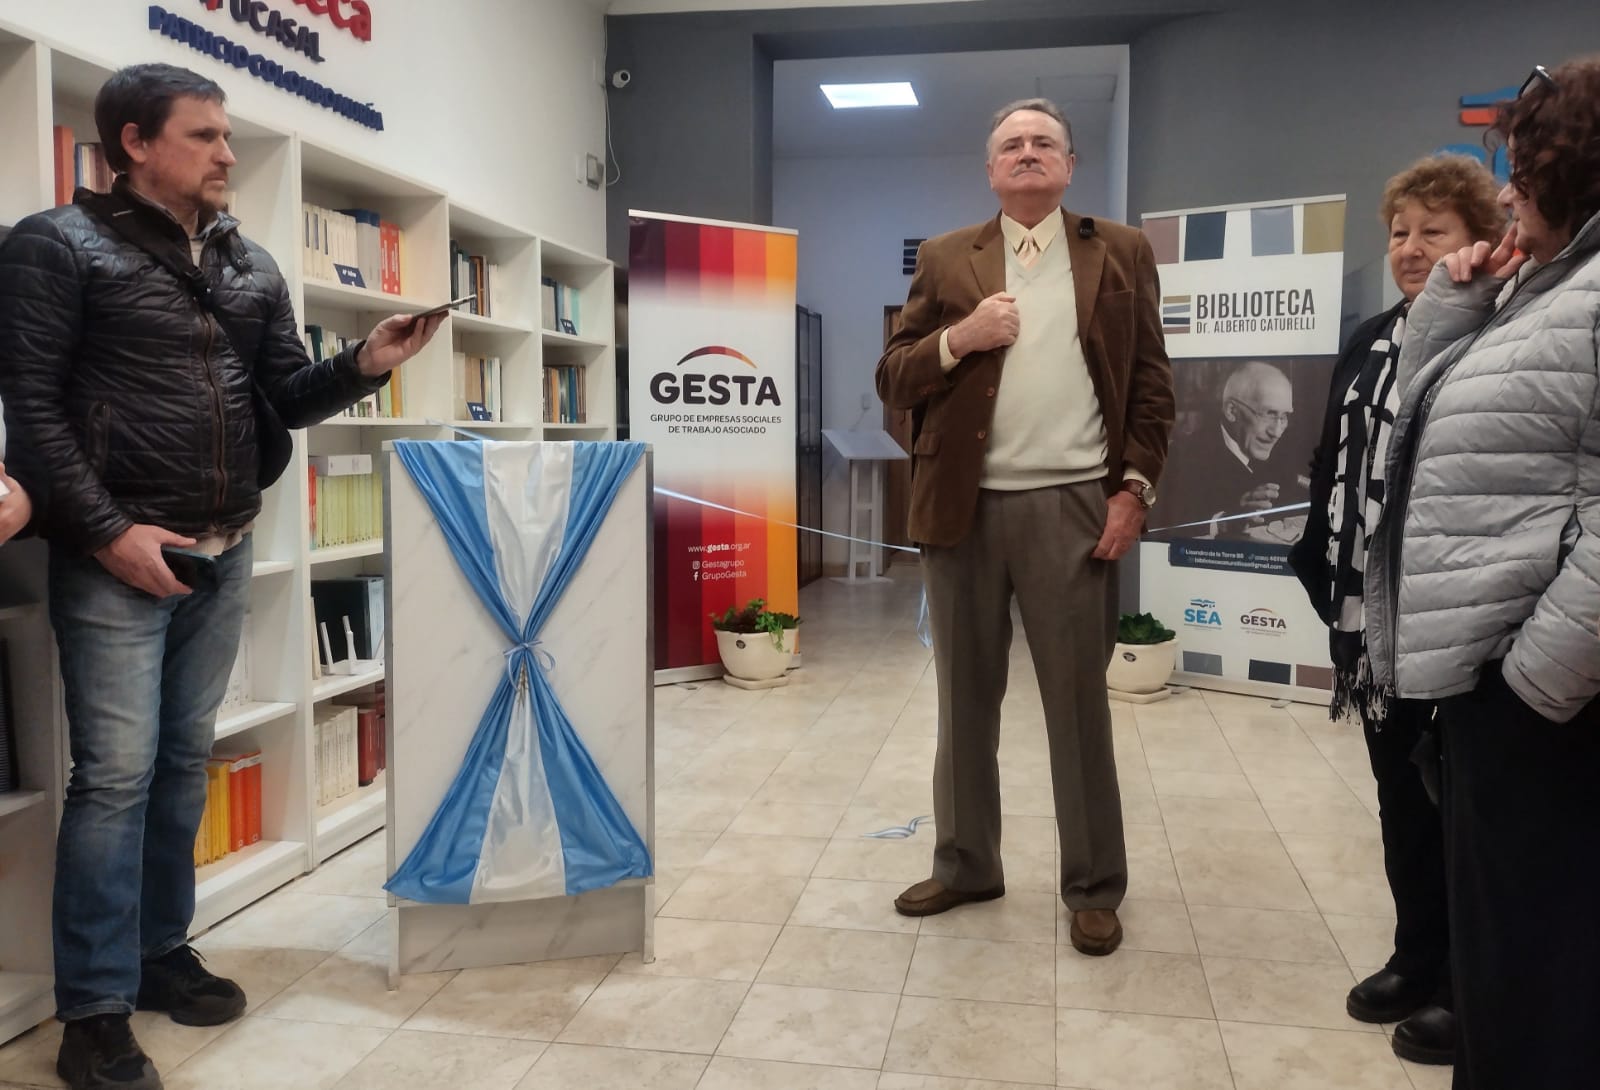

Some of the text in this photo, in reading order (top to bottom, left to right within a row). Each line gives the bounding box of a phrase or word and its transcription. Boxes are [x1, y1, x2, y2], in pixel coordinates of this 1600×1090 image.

[148, 5, 249, 68] PATRICIO
[1196, 288, 1316, 319] BIBLIOTECA
[1196, 316, 1316, 334] Dr. ALBERTO CATURELLI
[650, 371, 781, 407] GESTA
[650, 413, 782, 424] GRUPO DE EMPRESAS SOCIALES
[668, 425, 767, 435] DE TRABAJO ASOCIADO
[687, 542, 751, 553] www.gesta.org.ar
[701, 570, 747, 581] GrupoGesta
[1184, 608, 1221, 625] SEA
[1240, 614, 1287, 629] GESTA
